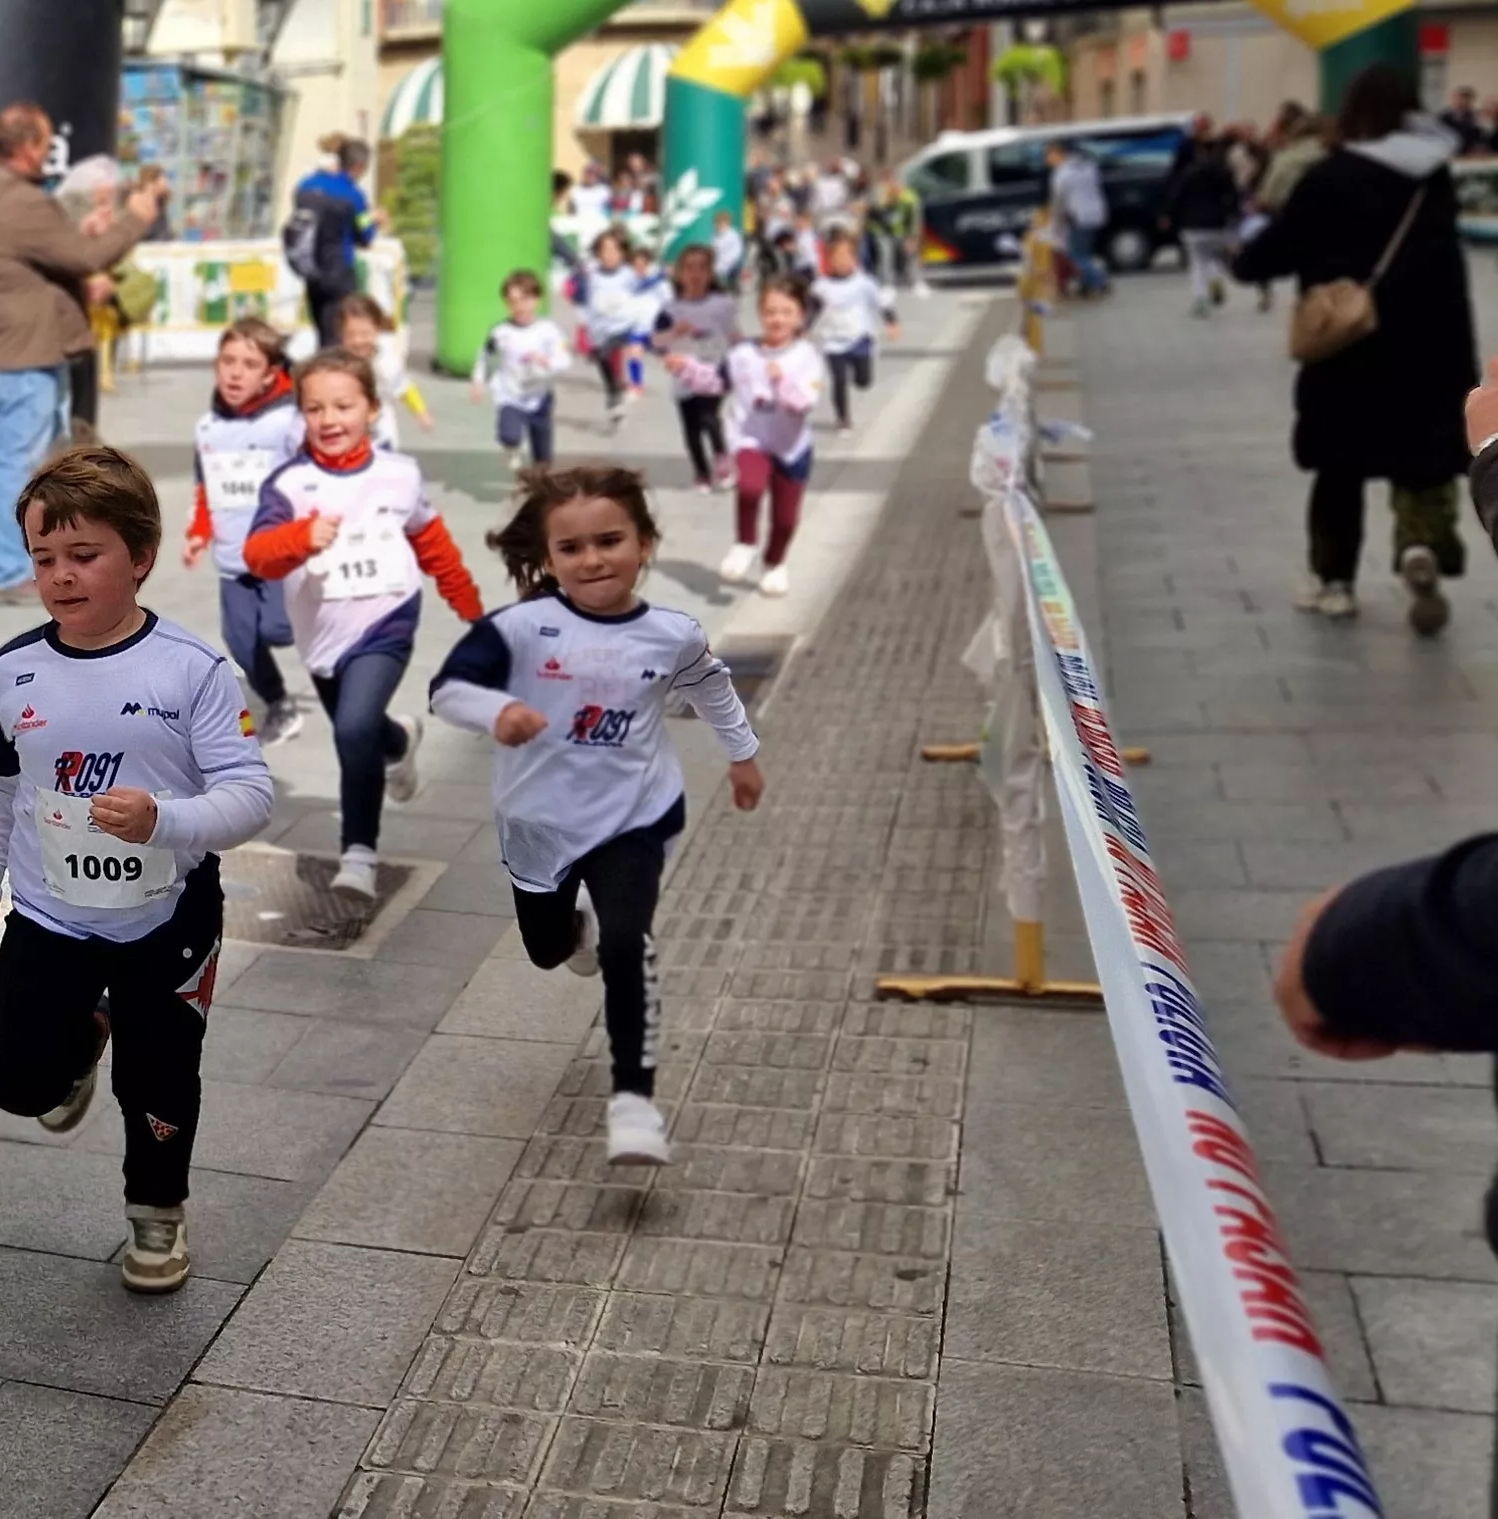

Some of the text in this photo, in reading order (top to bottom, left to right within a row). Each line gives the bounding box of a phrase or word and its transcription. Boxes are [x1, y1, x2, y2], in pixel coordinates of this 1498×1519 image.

[339, 559, 377, 580] 113
[147, 706, 180, 721] mupol
[65, 853, 143, 882] 1009
[1268, 1382, 1385, 1519] POL
